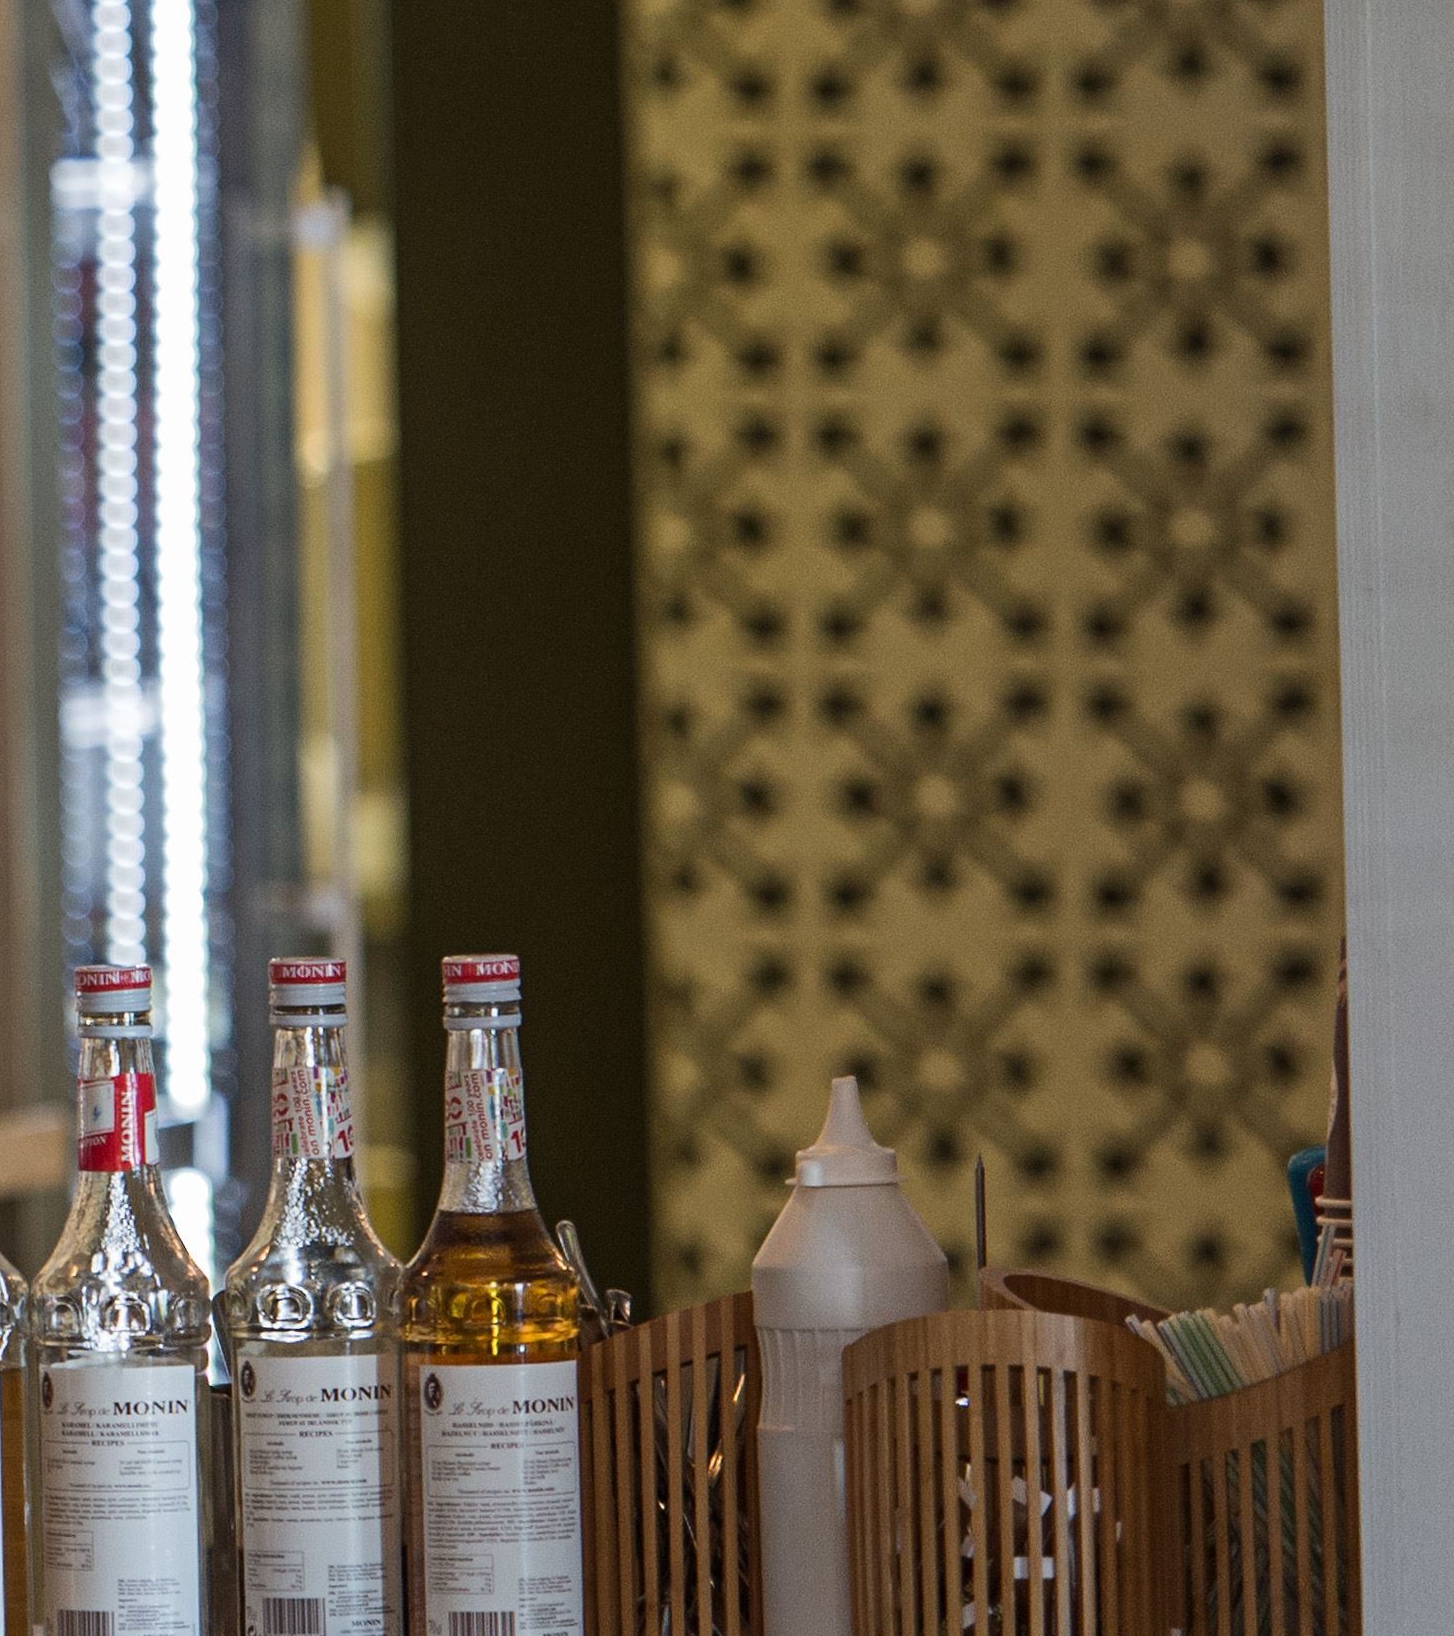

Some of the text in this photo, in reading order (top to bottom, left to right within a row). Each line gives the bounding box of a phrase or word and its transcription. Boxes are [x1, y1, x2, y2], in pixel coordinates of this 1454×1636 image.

[282, 964, 342, 978] MONIN
[466, 1100, 475, 1116] 100
[470, 1073, 494, 1160] on monin.com
[121, 1090, 134, 1163] MONIN
[310, 1140, 320, 1156] on
[321, 1384, 392, 1403] MONIN
[113, 1400, 189, 1415] MONIN
[512, 1396, 575, 1415] MONIN
